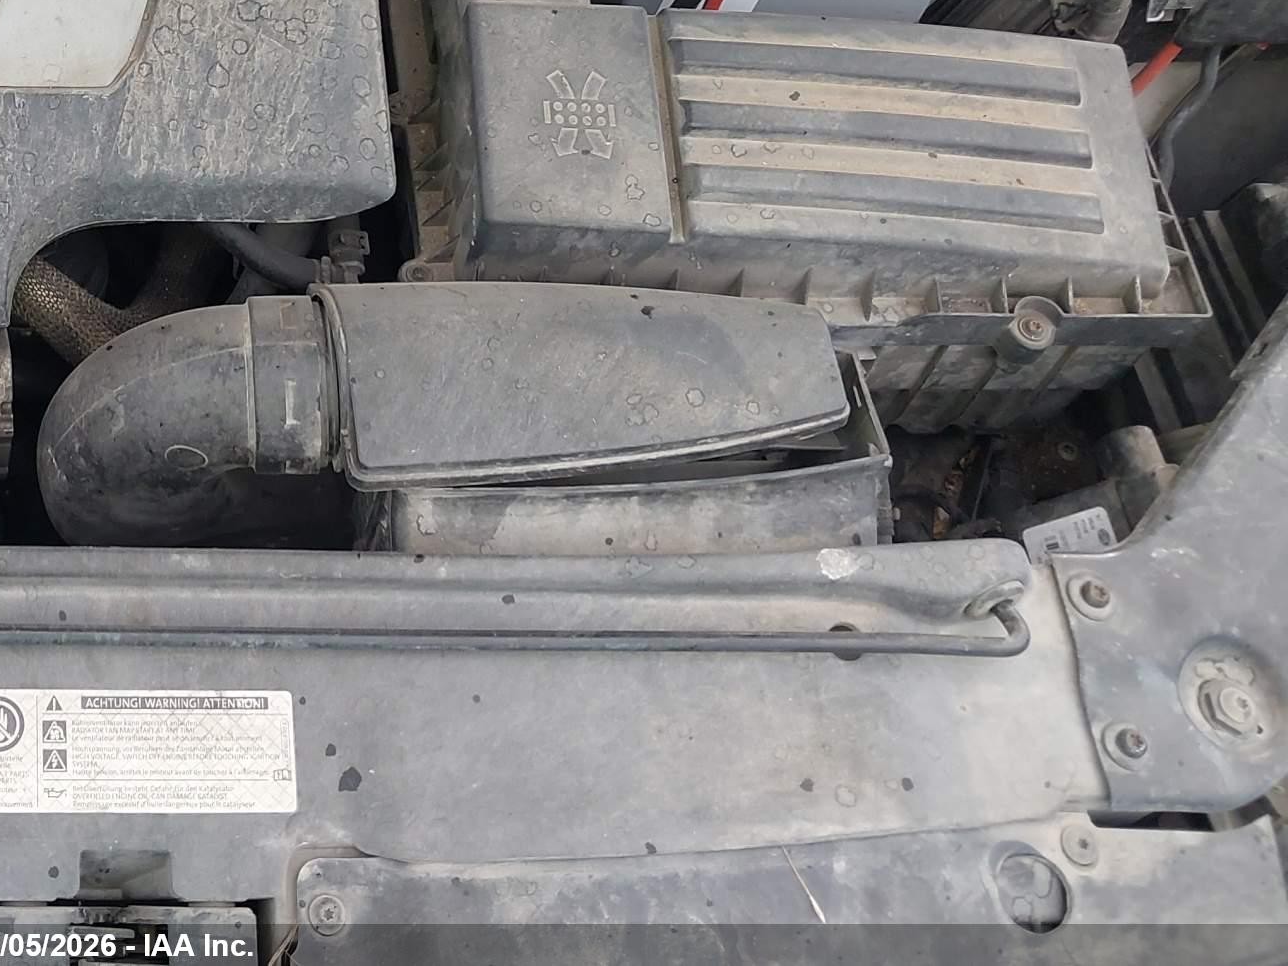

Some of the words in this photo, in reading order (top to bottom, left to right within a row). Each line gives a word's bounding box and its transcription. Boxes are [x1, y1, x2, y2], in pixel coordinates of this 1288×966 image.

[85, 697, 142, 709] ACHTUNG!
[144, 697, 200, 709] WARNING!
[202, 697, 265, 710] ATTENTION!
